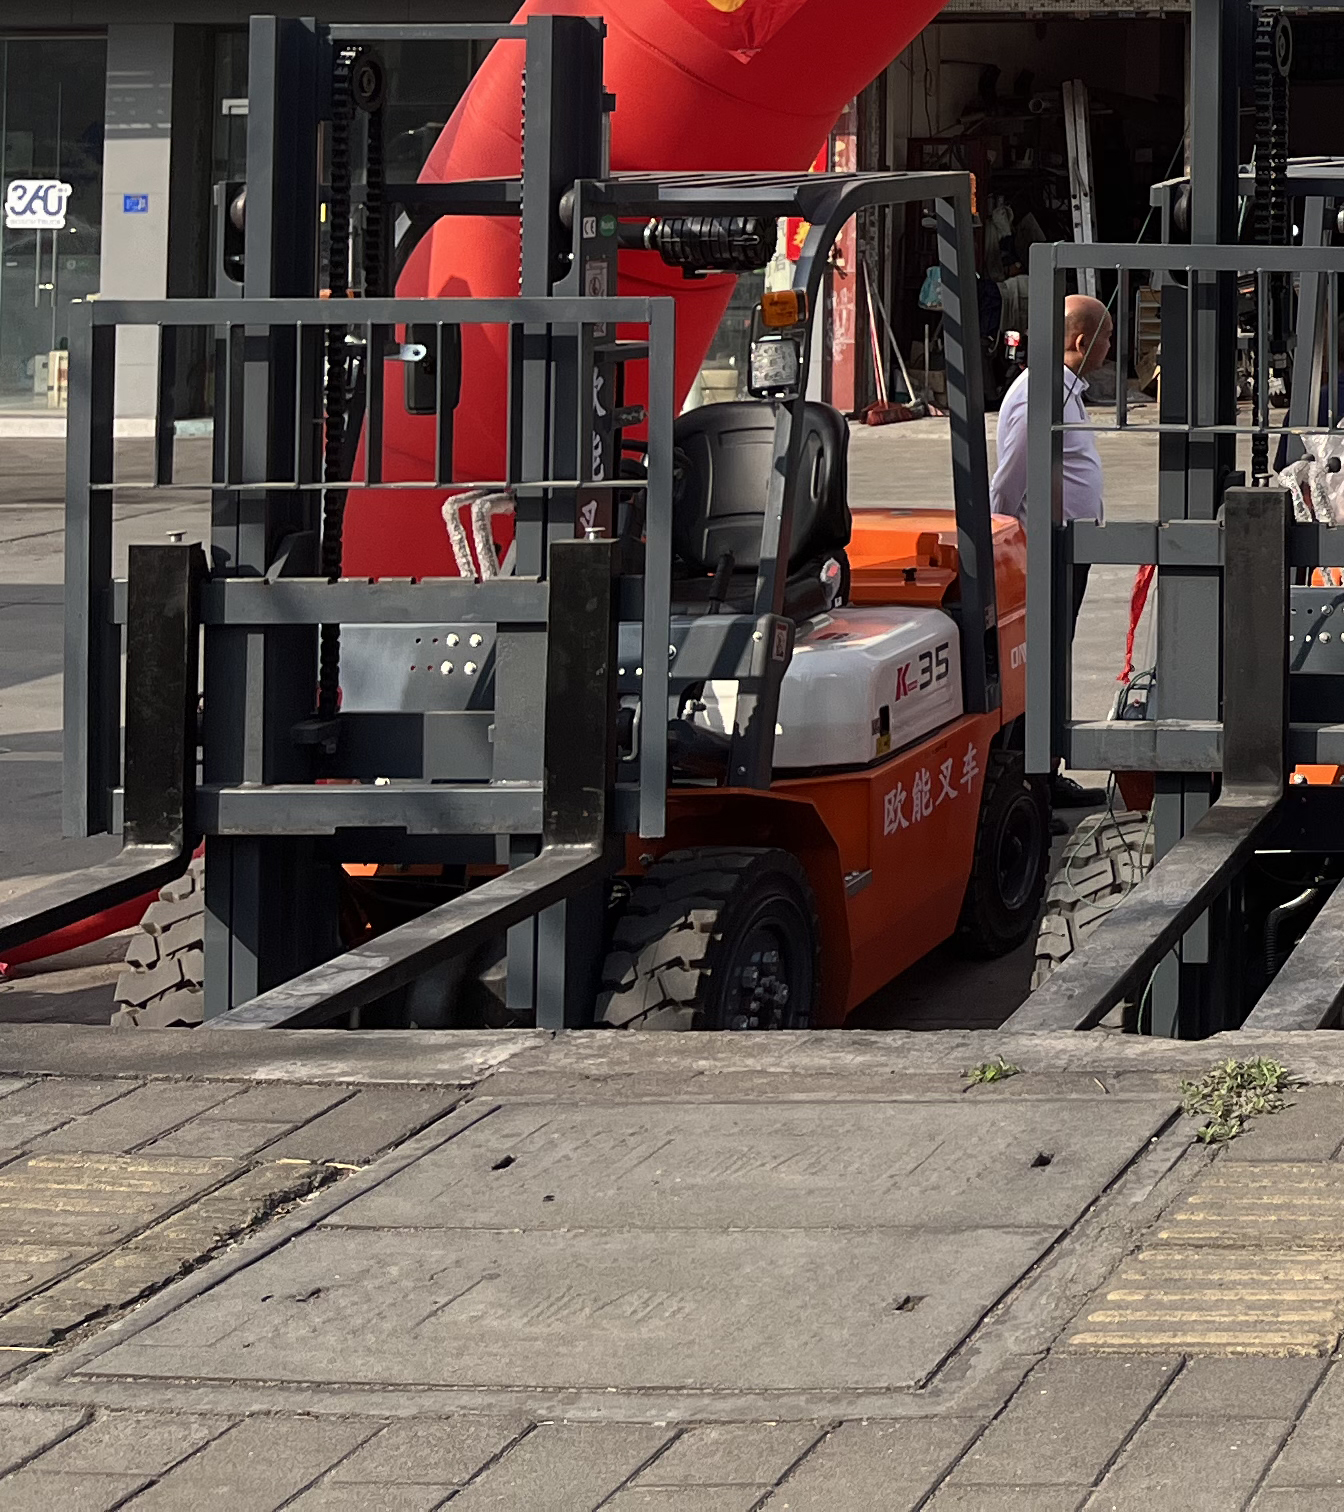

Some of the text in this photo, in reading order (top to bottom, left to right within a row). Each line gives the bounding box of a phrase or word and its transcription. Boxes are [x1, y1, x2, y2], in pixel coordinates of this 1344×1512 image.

[895, 642, 950, 703] K-35
[1010, 642, 1027, 670] ON
[883, 741, 980, 837] 欧能叉车
